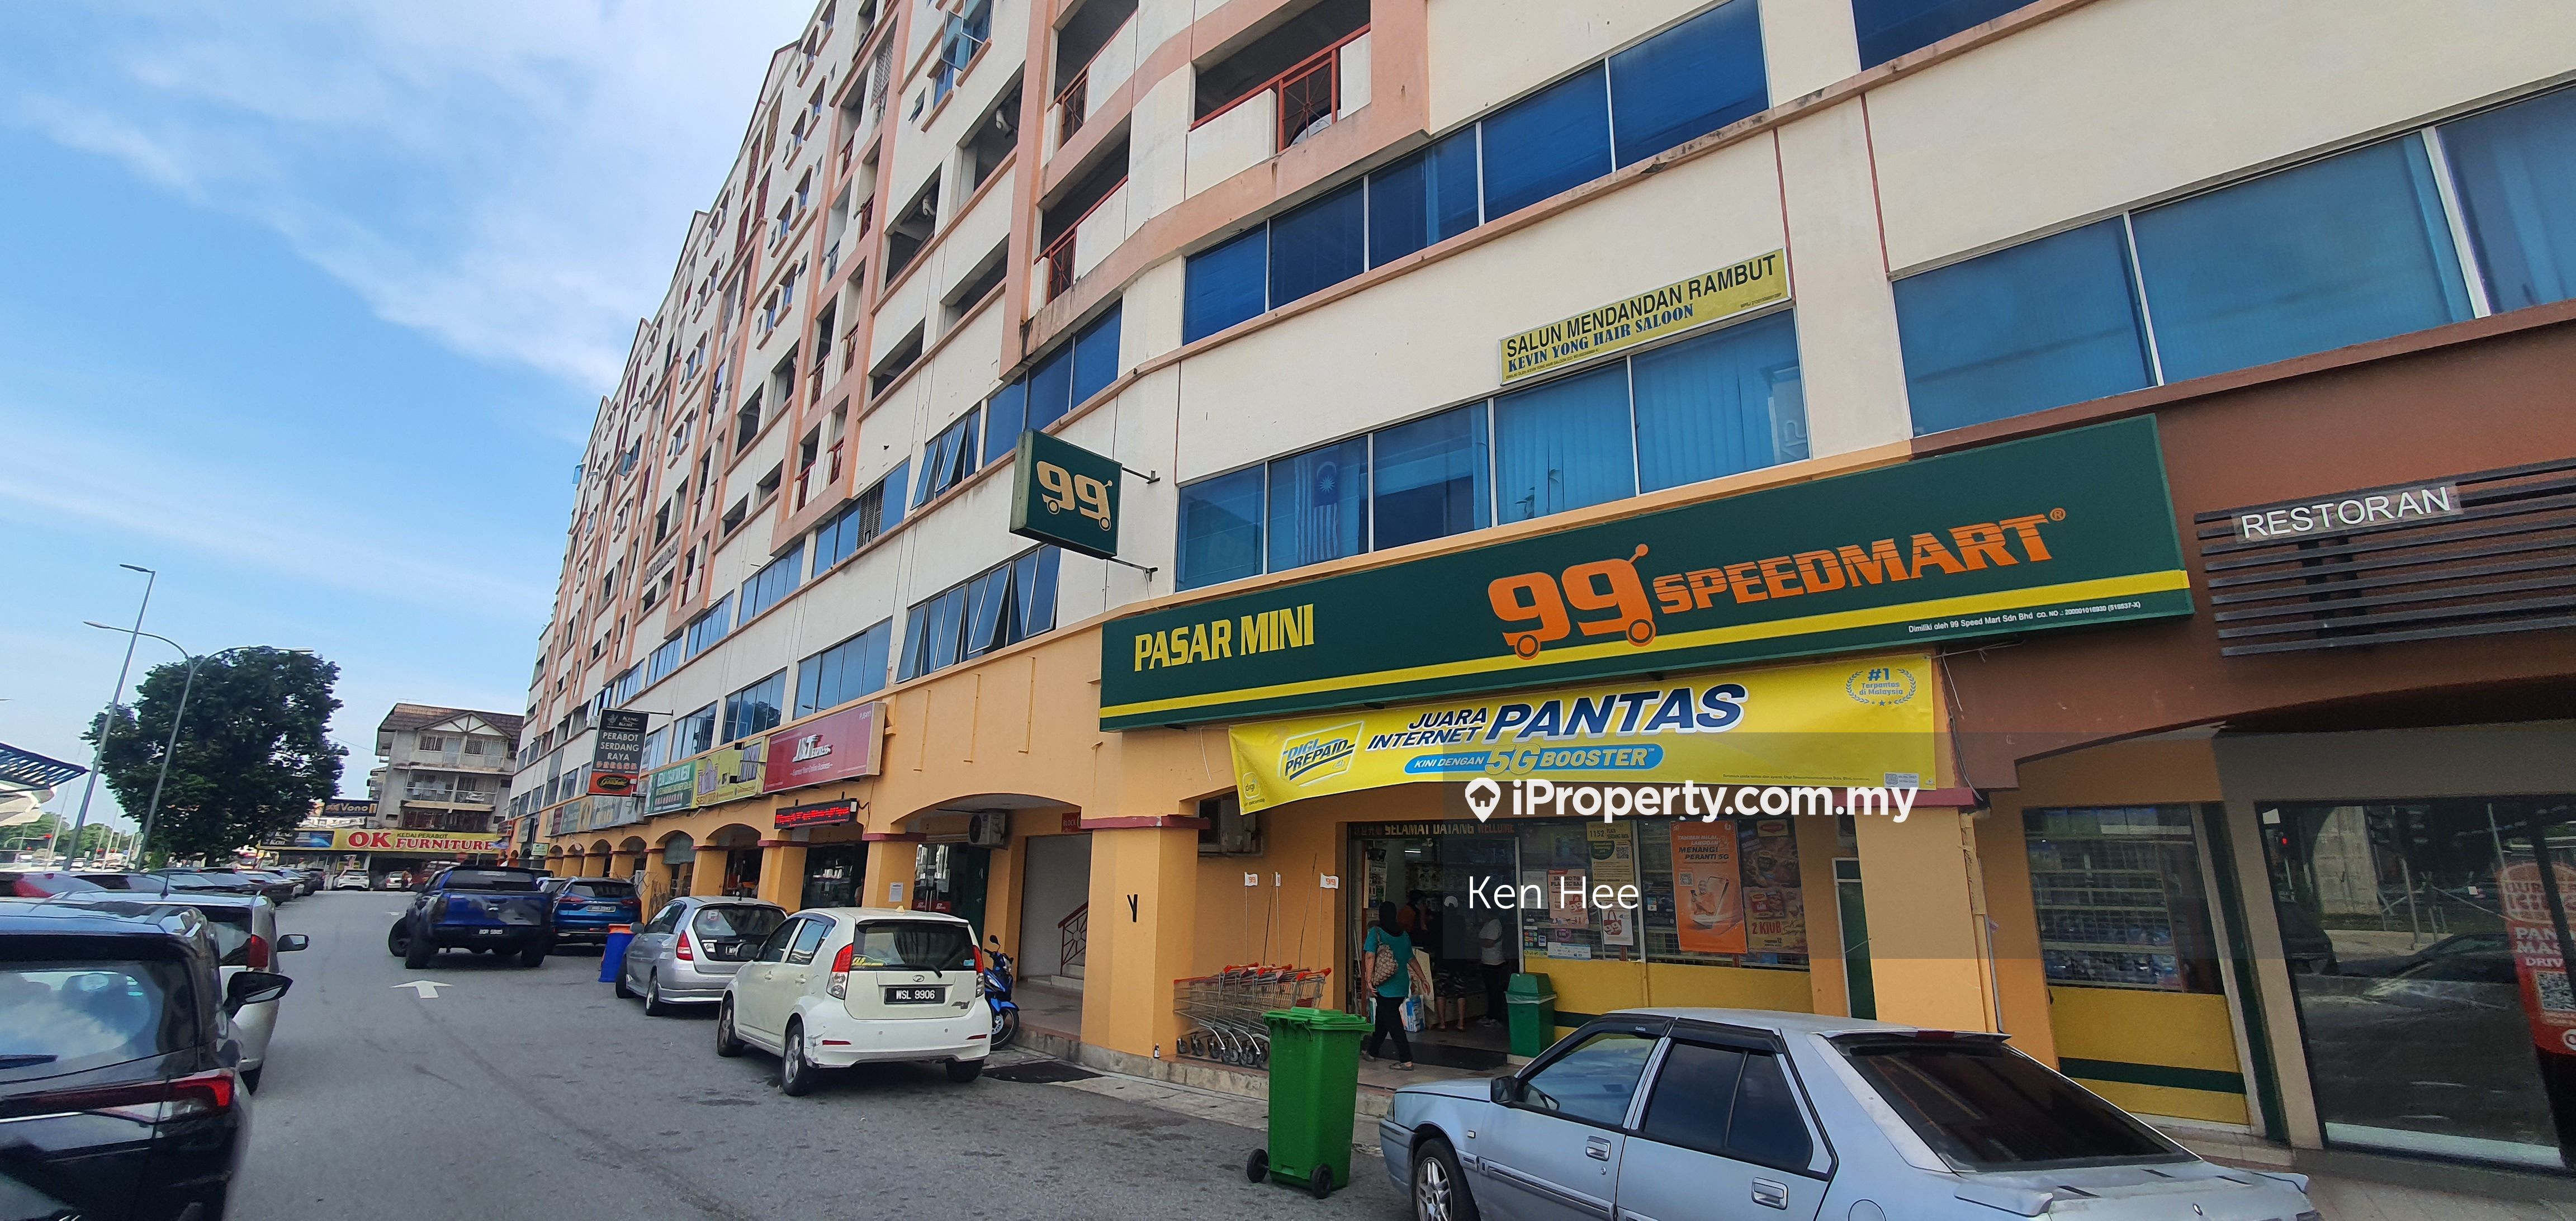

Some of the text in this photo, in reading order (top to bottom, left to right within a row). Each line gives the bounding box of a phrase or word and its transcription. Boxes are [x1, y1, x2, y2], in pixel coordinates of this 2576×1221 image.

[1506, 254, 1777, 357] SALUN MENDANDAN RAMBUT
[1507, 349, 1548, 373] KEVIN
[1551, 337, 1589, 358] YONG
[1593, 323, 1631, 347] HAIR
[1635, 304, 1694, 333] SALOON
[1036, 461, 1112, 531] 99
[2241, 486, 2452, 539] RESTORAN
[1488, 543, 1657, 661] 99
[1908, 623, 1933, 633] Dimiliki
[1960, 618, 1983, 628] Speed
[1984, 616, 2001, 625] Mart
[2002, 613, 2018, 623] Sdn
[2018, 612, 2034, 622] Bhd
[1134, 603, 1315, 673] PASAR MINI
[1867, 668, 1890, 682] #1
[1860, 682, 1901, 690] Terpantas
[1868, 688, 1903, 698] Malaysia
[1408, 707, 1488, 730] JUARA
[1483, 683, 1749, 745] PANTAS
[602, 732, 639, 742] PERABOT
[1366, 726, 1485, 752] INTERNET
[600, 741, 640, 752] SERDANG
[1287, 738, 1320, 758] DIGI
[607, 752, 630, 761] RAYA
[1285, 739, 1349, 776] PREPAID
[1413, 744, 1649, 775] KINI DENGAN 5G BOOSTER
[1246, 783, 1256, 792] digi
[341, 803, 368, 812] Vono
[348, 831, 391, 849] OK
[395, 839, 493, 851] FURNITURE
[1325, 878, 1337, 886] 99
[1752, 922, 1759, 935] 2
[1760, 921, 1782, 935] KIUB
[2516, 927, 2559, 940] PAN
[2525, 957, 2564, 967] DRIV
[896, 989, 936, 1000] WSL 9906
